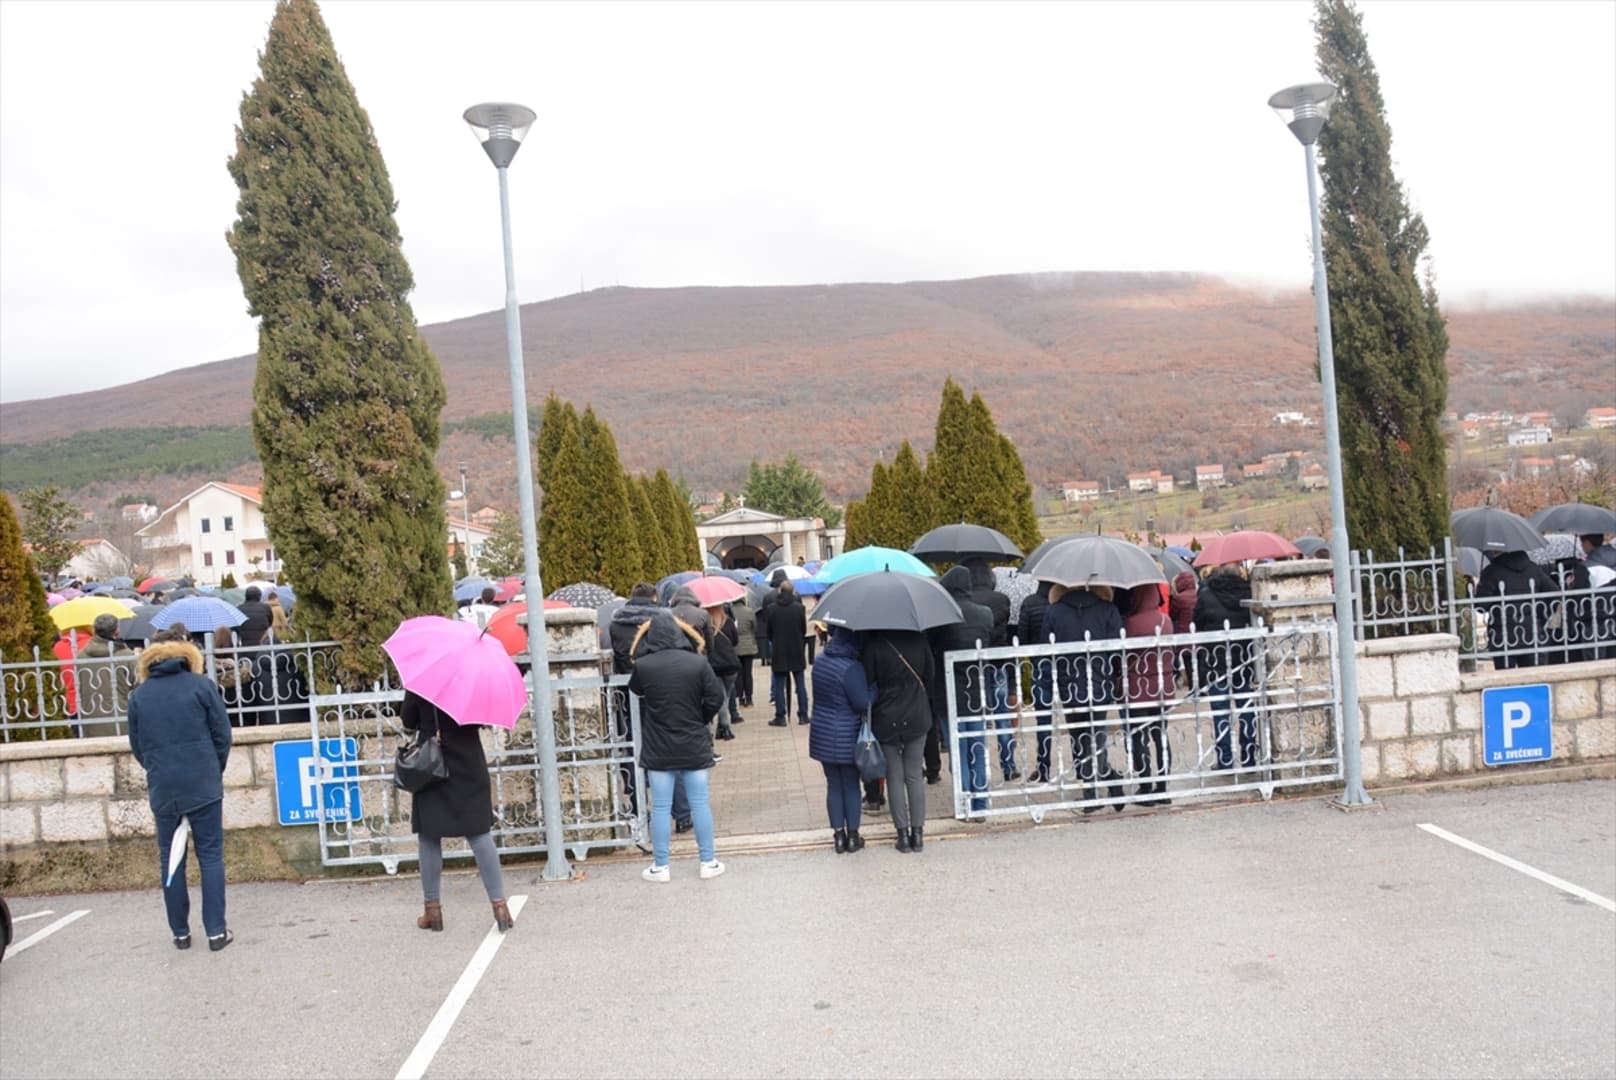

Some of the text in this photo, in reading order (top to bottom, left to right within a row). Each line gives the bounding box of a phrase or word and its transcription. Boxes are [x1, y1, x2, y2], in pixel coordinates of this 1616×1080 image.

[1502, 701, 1532, 749] P
[1493, 751, 1503, 761] ZA
[289, 810, 301, 820] ZA
